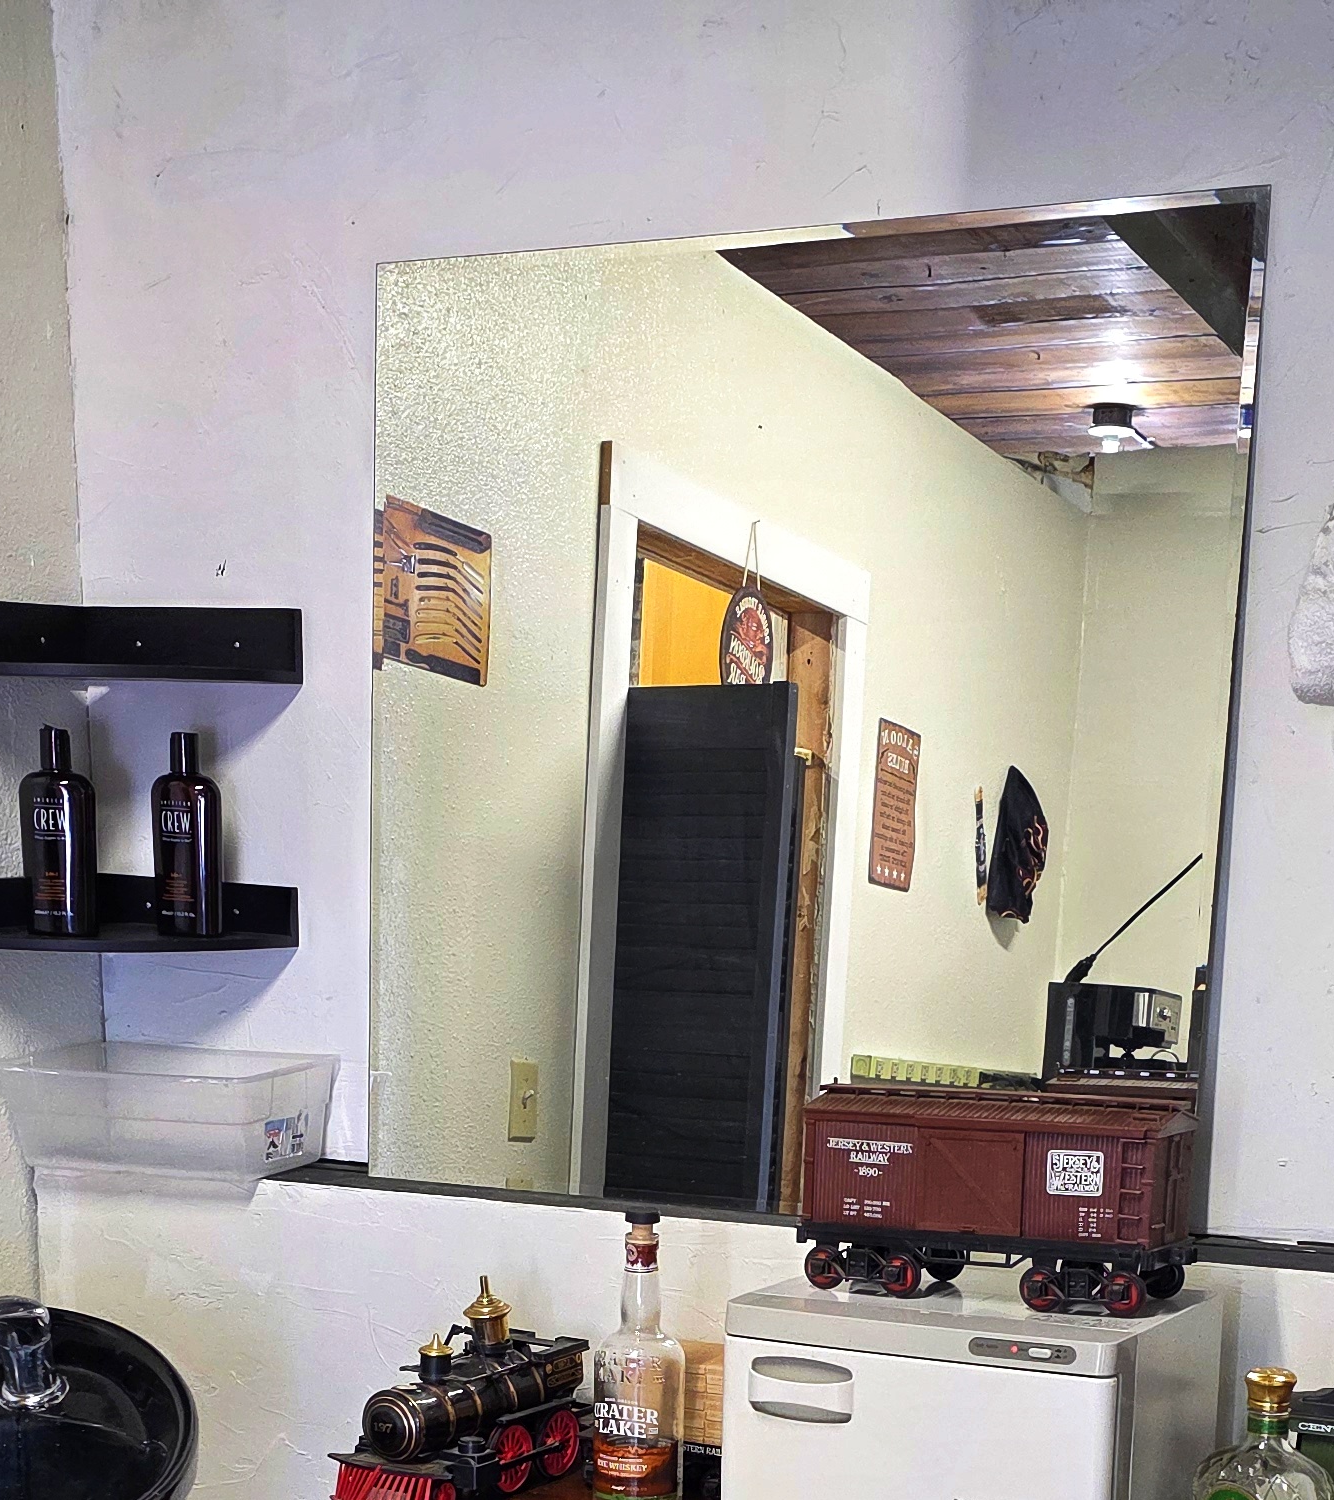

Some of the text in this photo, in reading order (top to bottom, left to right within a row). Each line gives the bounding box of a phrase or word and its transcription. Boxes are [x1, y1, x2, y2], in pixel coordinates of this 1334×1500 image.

[33, 808, 67, 831] CREW
[850, 1151, 890, 1163] RAILWAY
[594, 1402, 659, 1426] CRATER
[598, 1418, 647, 1439] LAKE
[609, 1461, 648, 1472] WHISKEY
